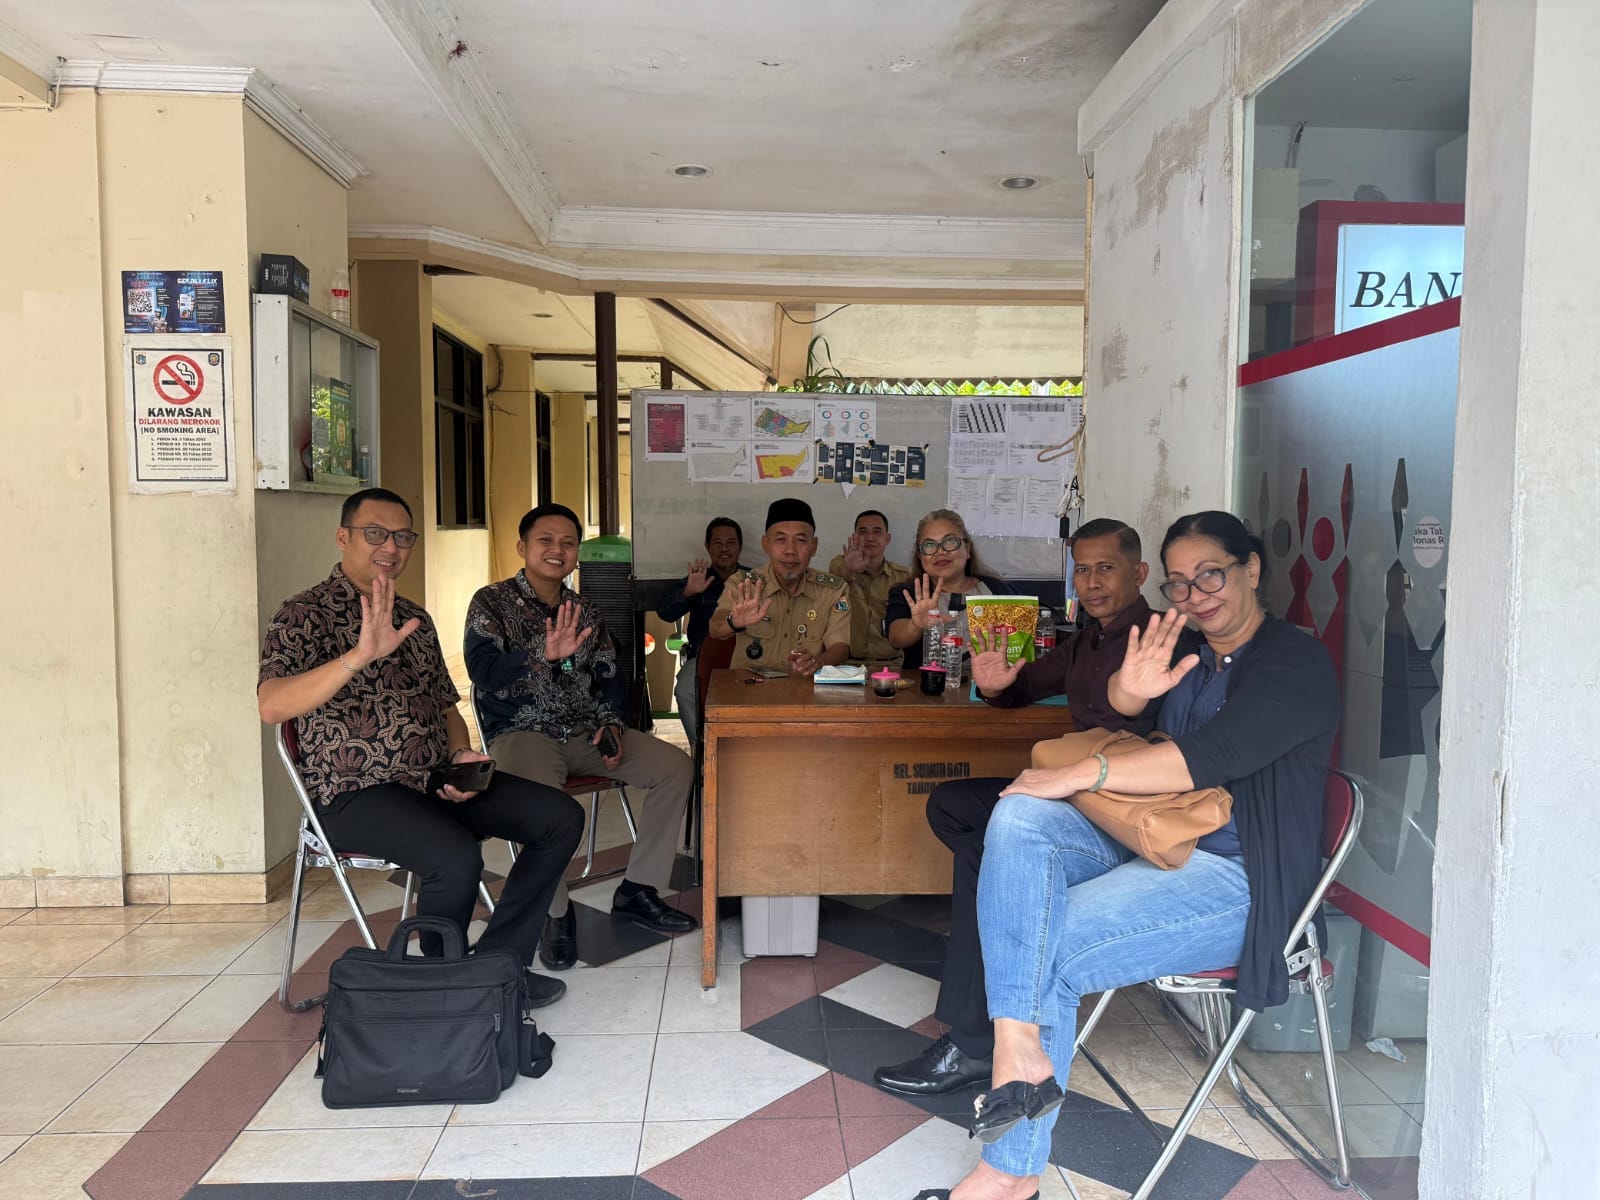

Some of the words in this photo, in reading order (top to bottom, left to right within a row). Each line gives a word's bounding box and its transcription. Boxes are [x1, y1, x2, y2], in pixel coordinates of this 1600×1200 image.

[148, 407, 212, 418] KAWASAN
[138, 418, 179, 426] DILARANG
[180, 418, 221, 426] MEROKOK
